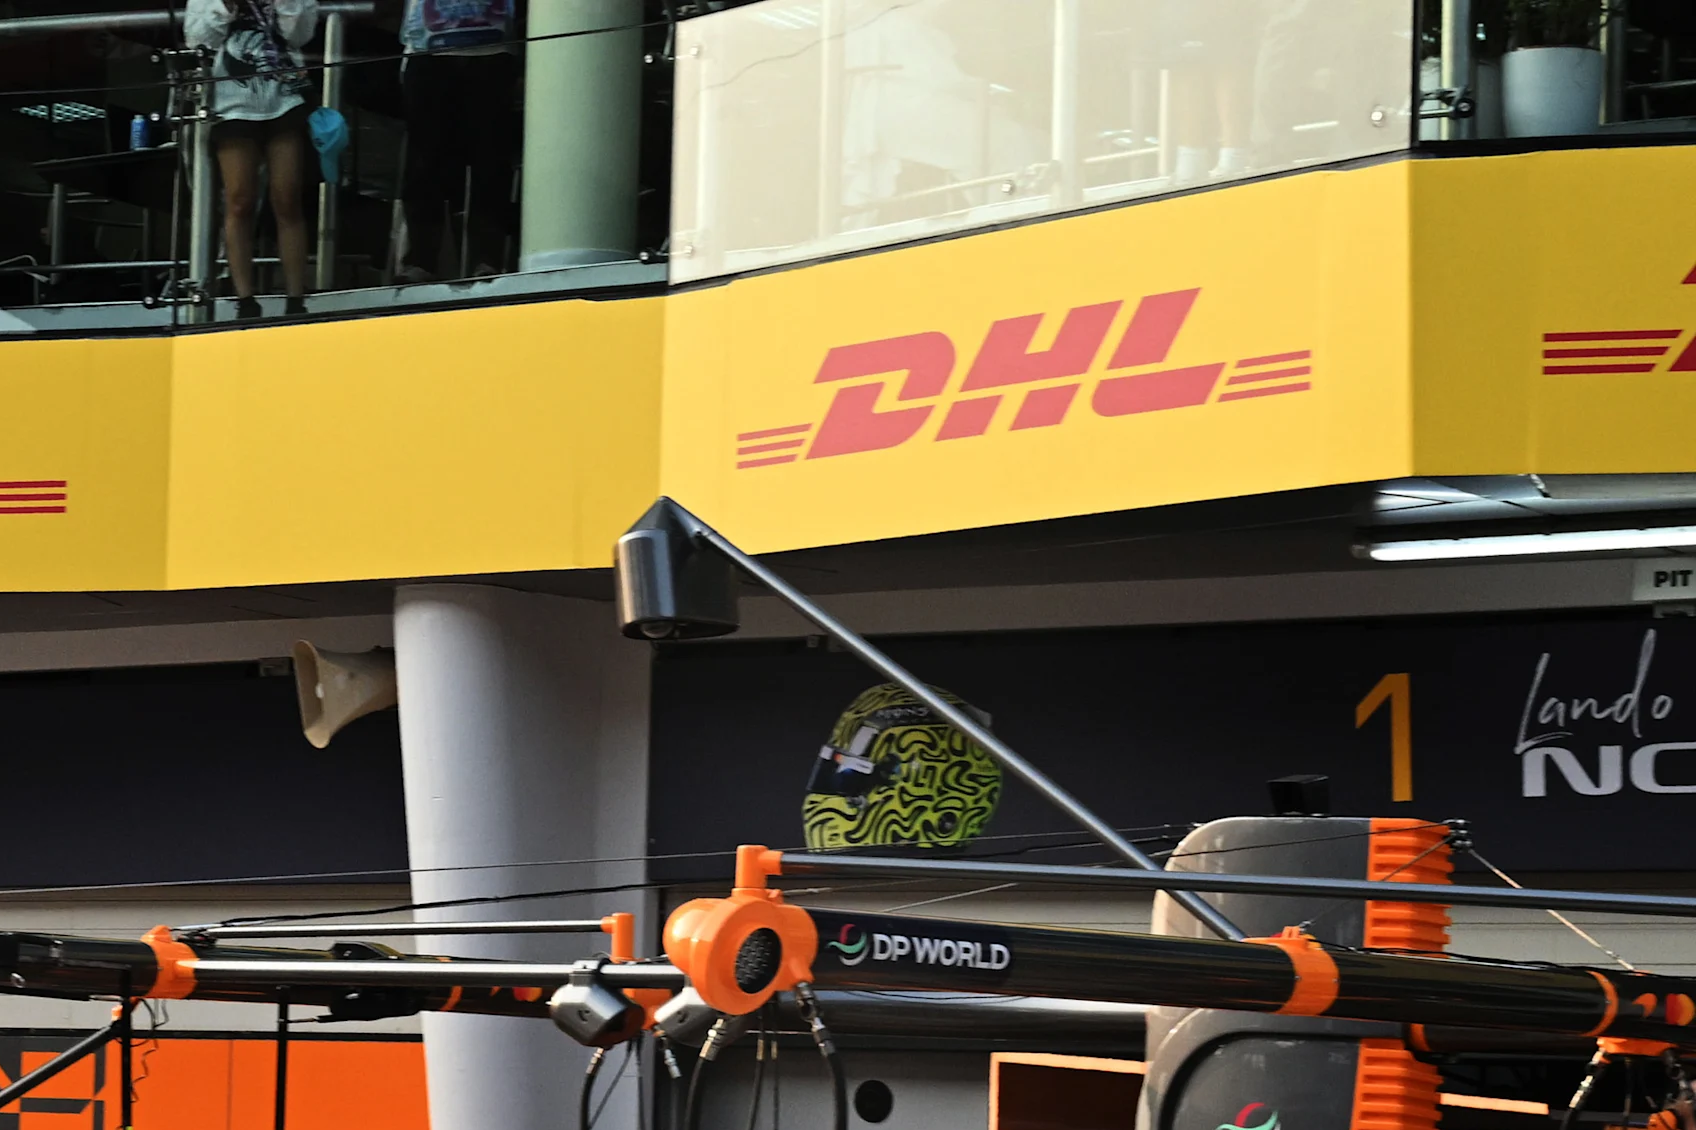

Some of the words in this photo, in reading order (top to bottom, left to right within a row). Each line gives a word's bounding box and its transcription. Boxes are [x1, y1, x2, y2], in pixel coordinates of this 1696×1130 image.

[805, 287, 1226, 461] DHL
[1653, 570, 1692, 588] PIT
[1355, 673, 1412, 801] 1
[1514, 628, 1673, 755] Lando
[872, 933, 911, 961] DP
[912, 936, 1011, 970] WORLD
